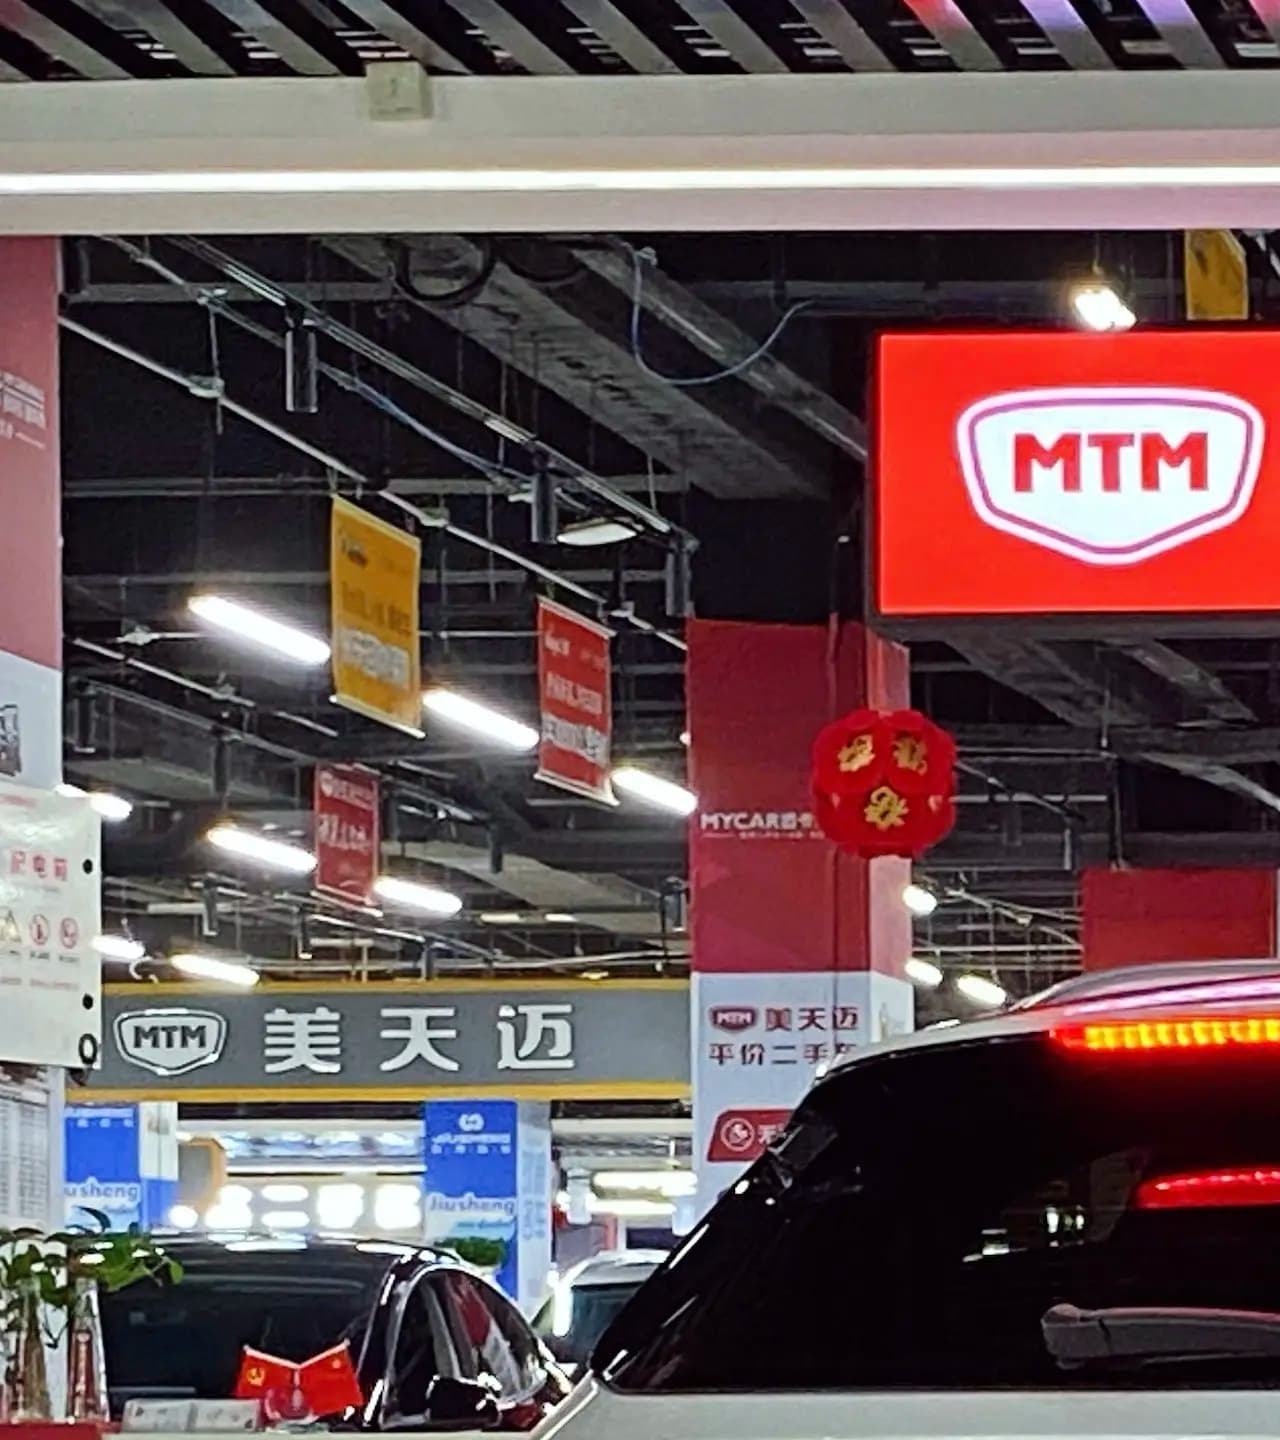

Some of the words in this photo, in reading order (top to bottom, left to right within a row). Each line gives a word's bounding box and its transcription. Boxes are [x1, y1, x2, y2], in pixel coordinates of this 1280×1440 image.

[1013, 432, 1209, 495] MTM
[133, 1024, 207, 1049] MTM
[264, 1004, 575, 1074] 美天迈
[765, 1006, 859, 1031] 美天迈
